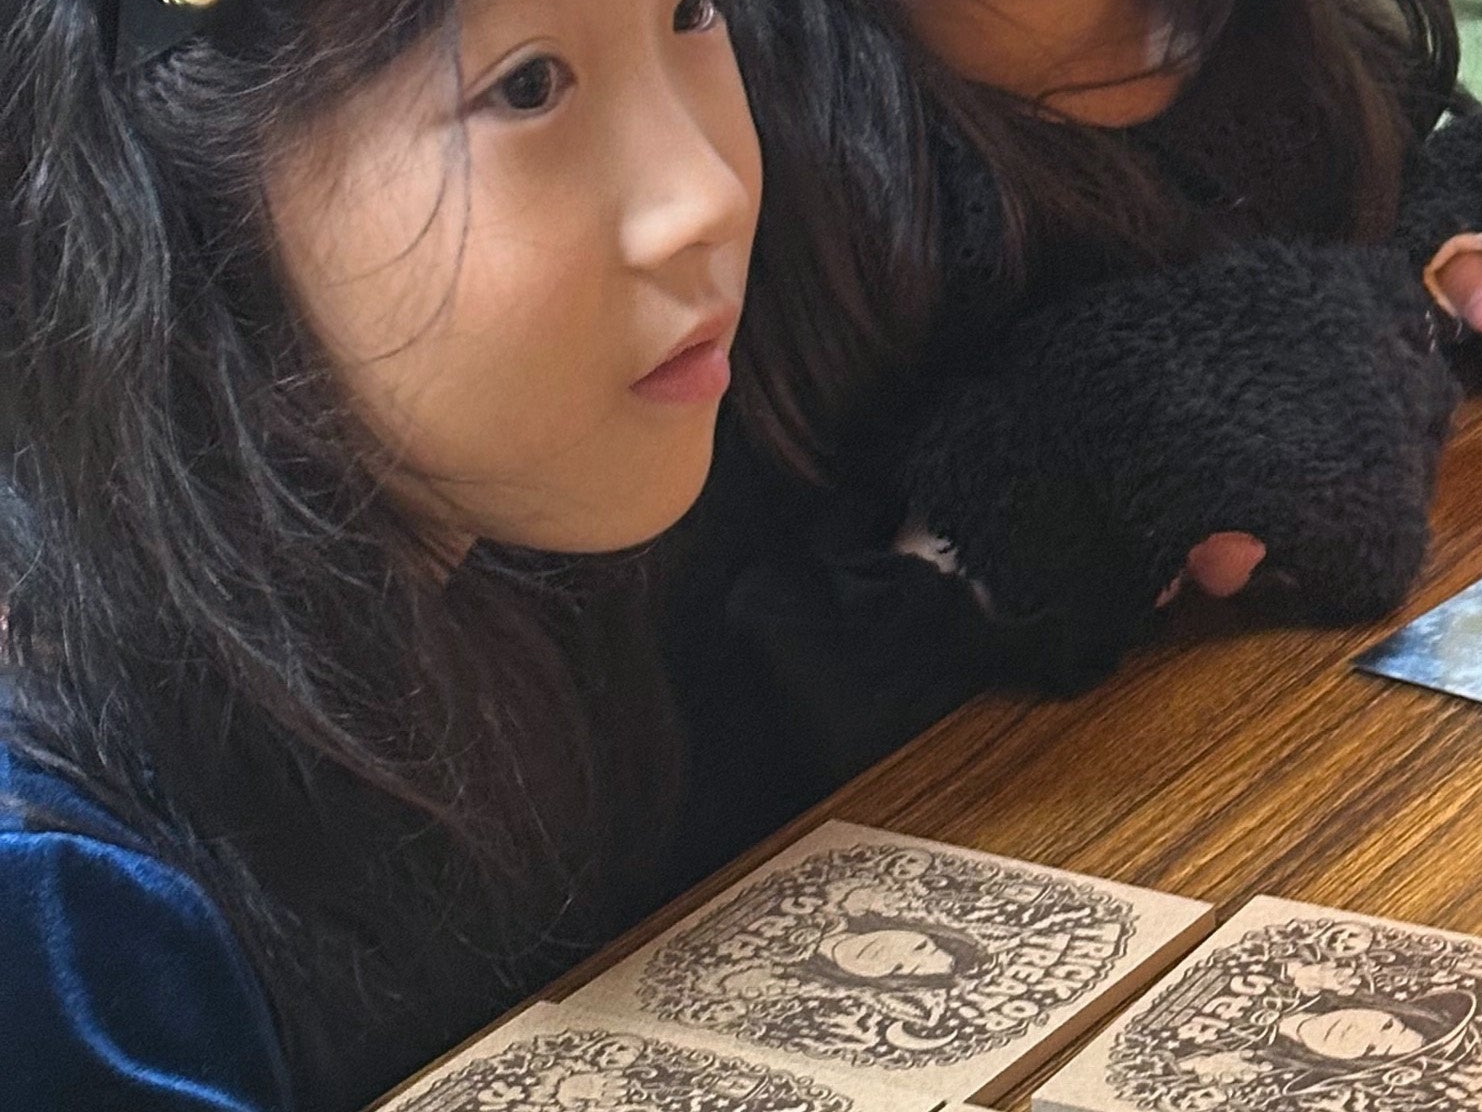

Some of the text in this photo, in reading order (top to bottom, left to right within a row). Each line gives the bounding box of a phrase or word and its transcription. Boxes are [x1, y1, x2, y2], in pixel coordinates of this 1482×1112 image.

[948, 933, 1072, 1019] TREAT!
[972, 923, 1122, 1032] TRICK OR
